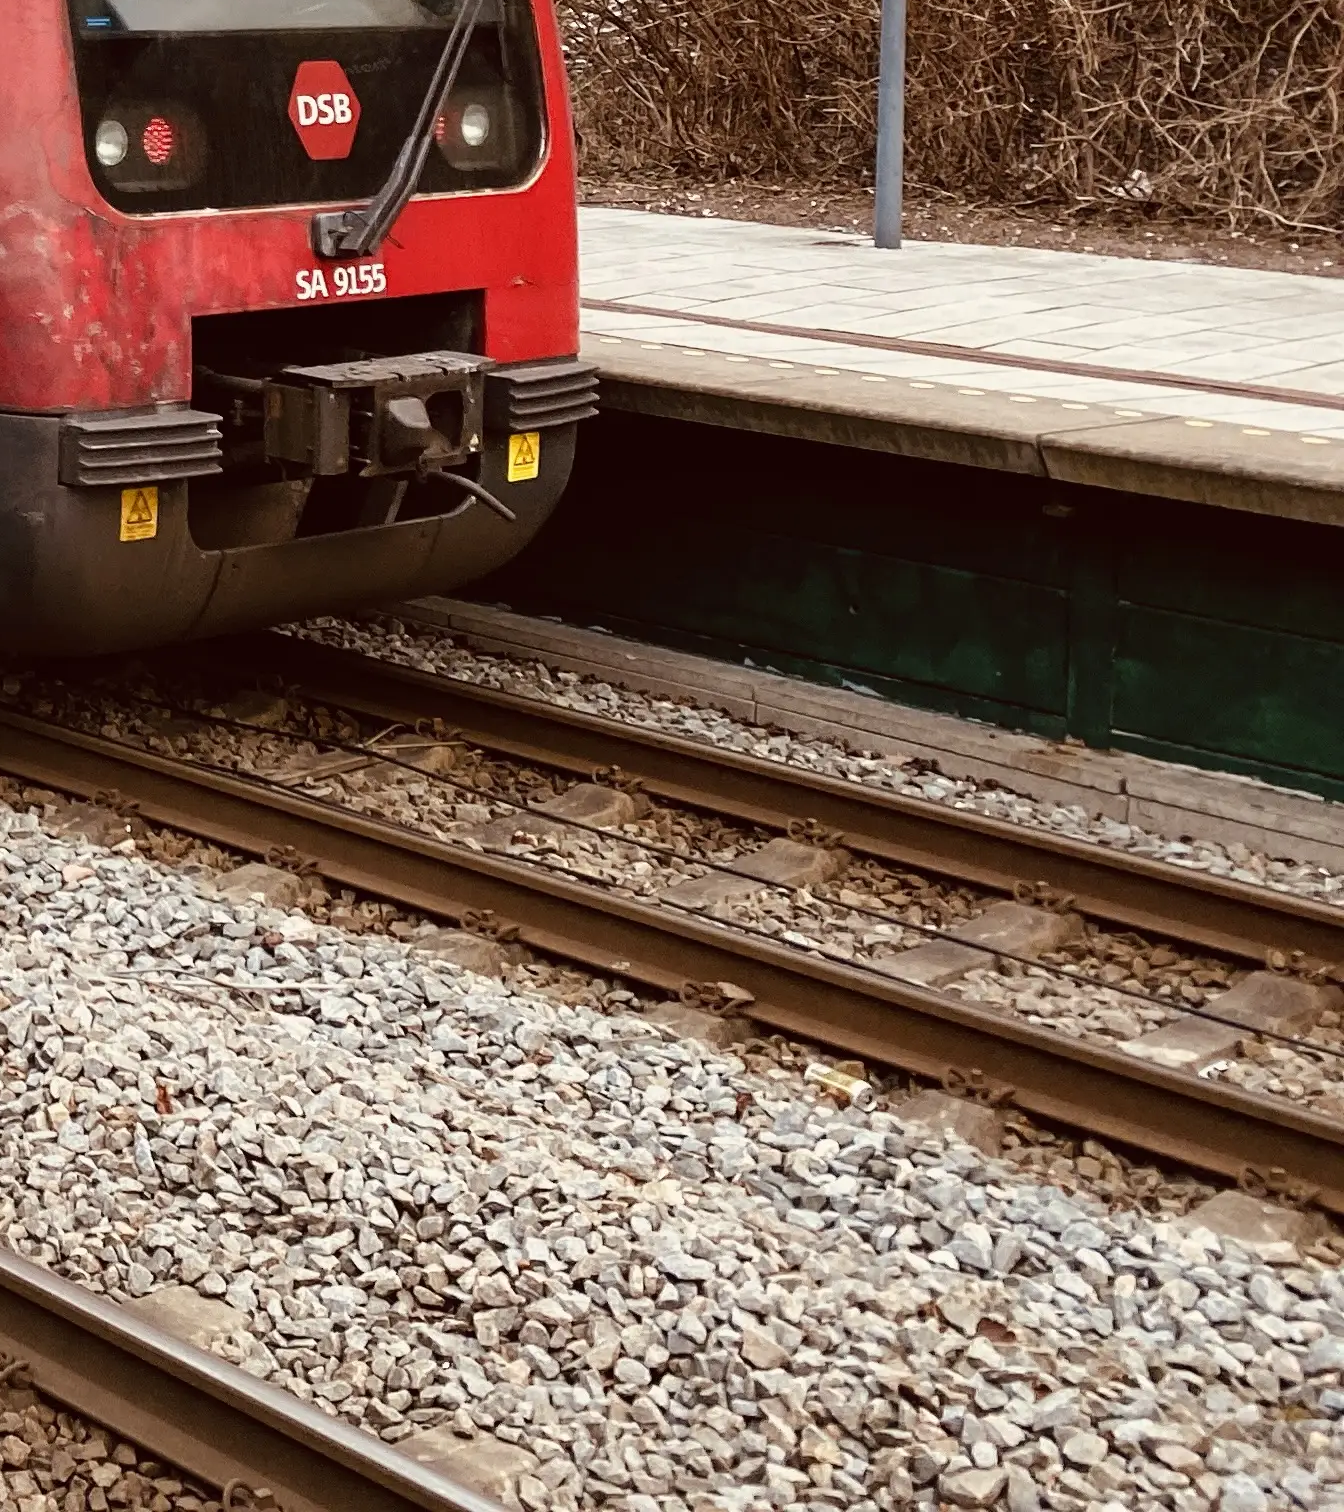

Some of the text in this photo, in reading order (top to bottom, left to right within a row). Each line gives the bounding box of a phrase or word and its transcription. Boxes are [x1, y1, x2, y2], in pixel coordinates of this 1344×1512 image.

[296, 93, 353, 126] DSB
[295, 263, 387, 300] SA 9155
